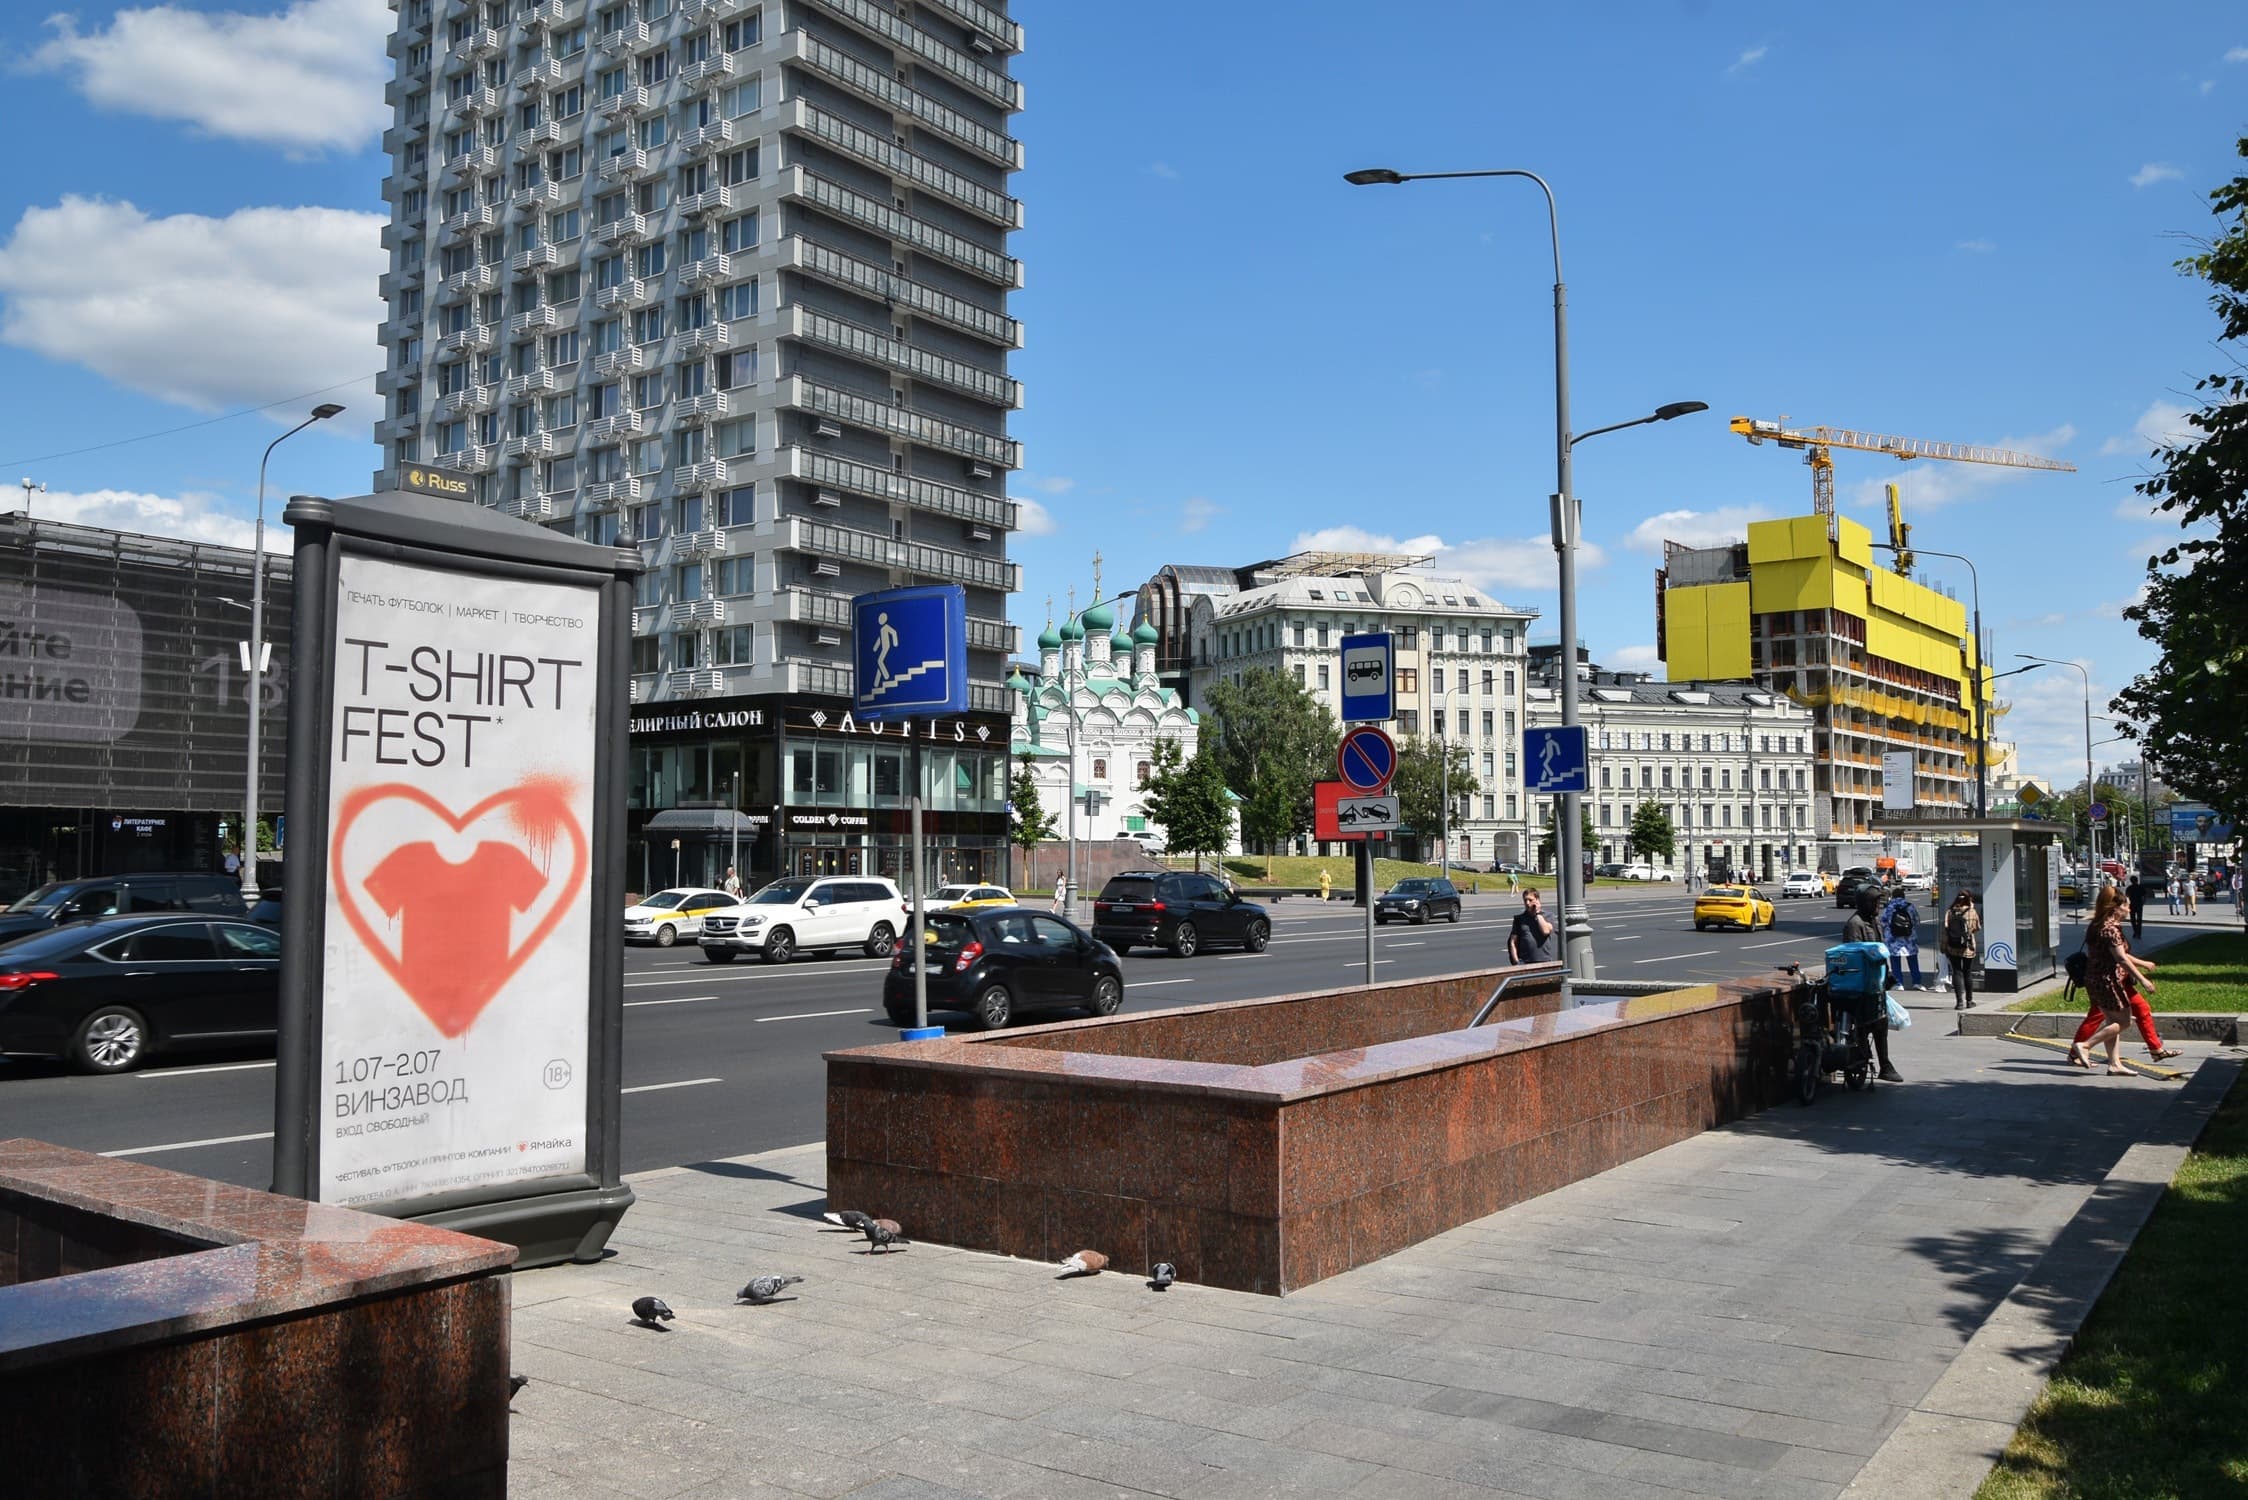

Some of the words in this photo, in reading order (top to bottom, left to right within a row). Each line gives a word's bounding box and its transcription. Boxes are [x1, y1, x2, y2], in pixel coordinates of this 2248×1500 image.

[428, 474, 467, 493] Russ
[347, 590, 386, 607] ПЕЧАТЬ
[388, 597, 444, 614] ФУТБОЛОК
[456, 606, 500, 621] МАРКЕТ
[512, 612, 584, 629] ТВОРЧЕСТВО
[0, 673, 90, 703] ние
[345, 638, 582, 710] T-SHIRT
[704, 710, 763, 728] САЛОН
[548, 1066, 571, 1082] 18+
[335, 1078, 468, 1118] ВИНЗАВОД
[336, 1124, 364, 1138] ВХОД
[366, 1112, 430, 1133] СВОБОДНЫЙ
